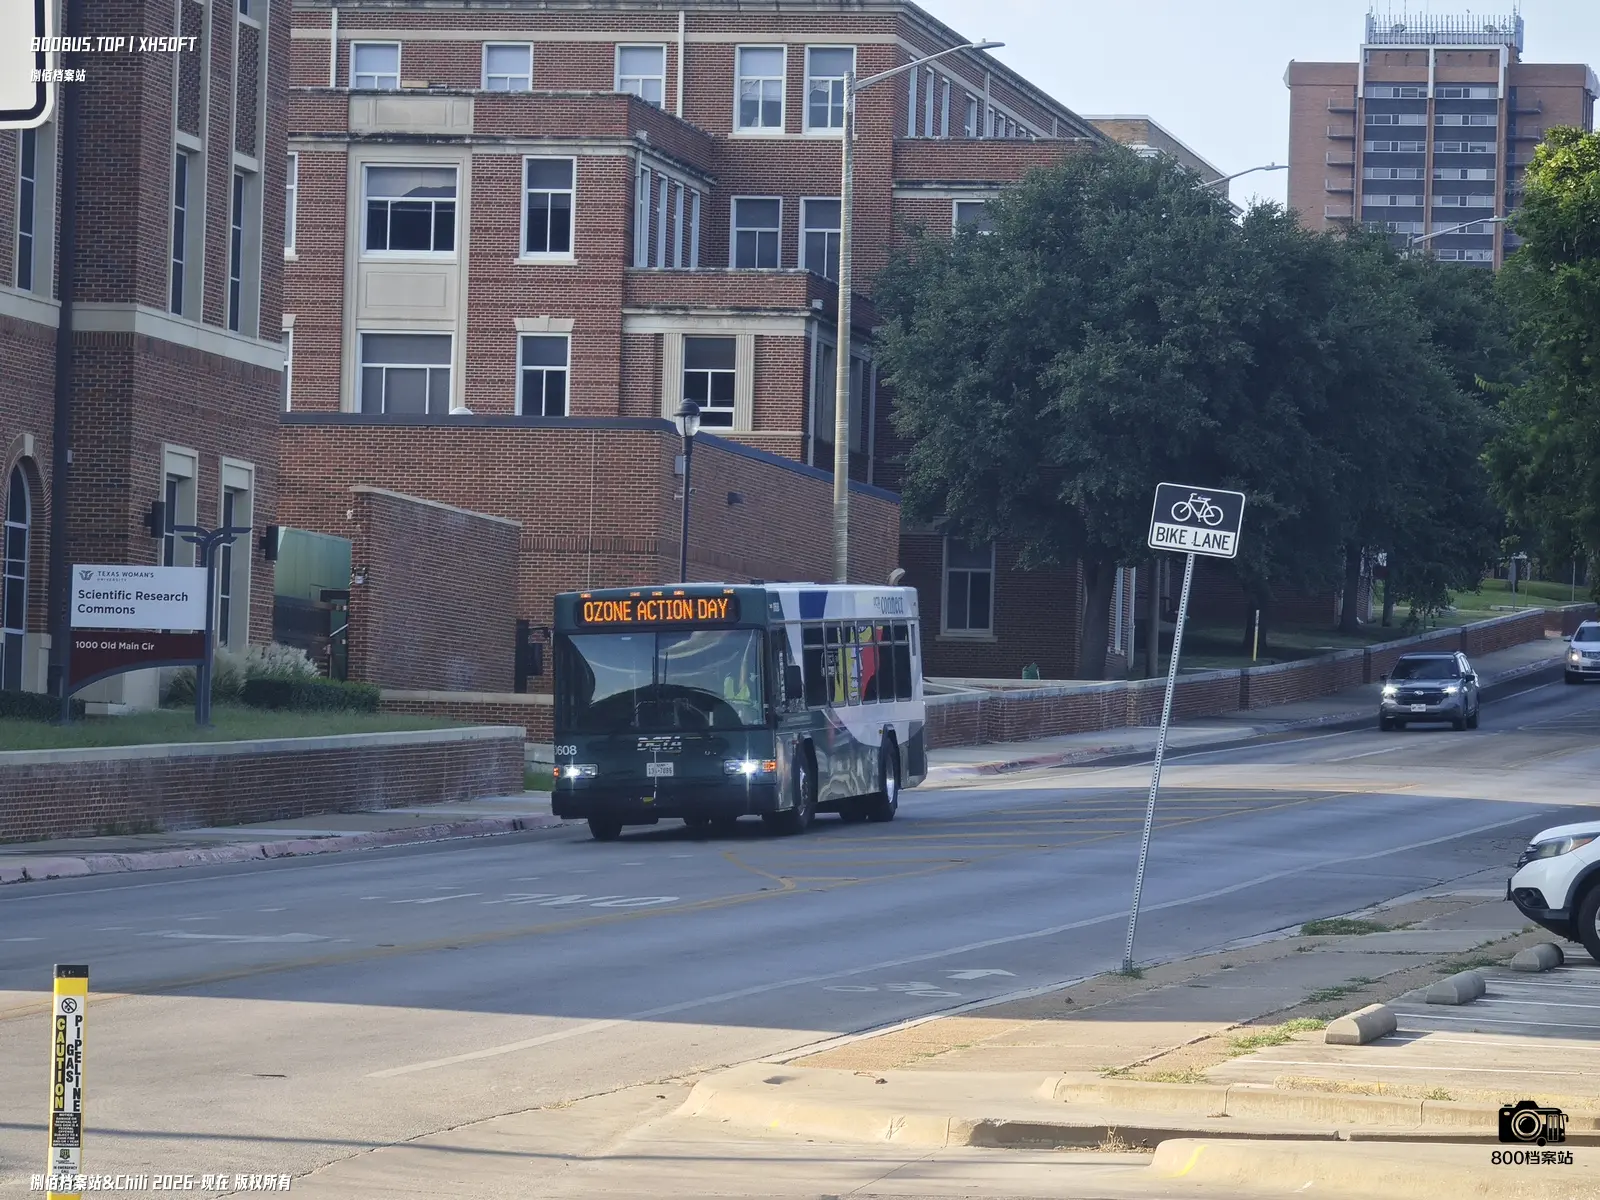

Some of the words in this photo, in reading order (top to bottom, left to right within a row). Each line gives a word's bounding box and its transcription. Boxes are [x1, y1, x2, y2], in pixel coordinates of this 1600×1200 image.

[1156, 526, 1188, 545] BIKE
[1193, 531, 1231, 551] LANE
[78, 589, 132, 601] Scientific
[135, 591, 188, 602] Research
[77, 604, 136, 615] Commons
[583, 601, 632, 622] OZONE
[637, 599, 693, 621] ACTION
[697, 598, 728, 619] DAY
[75, 640, 98, 649] 1000
[100, 641, 116, 650] Old
[118, 642, 140, 650] Main
[141, 642, 155, 651] Cir
[54, 1017, 66, 1109] CAUTION
[66, 1043, 74, 1083] GAS
[73, 1014, 83, 1112] PIPELINE
